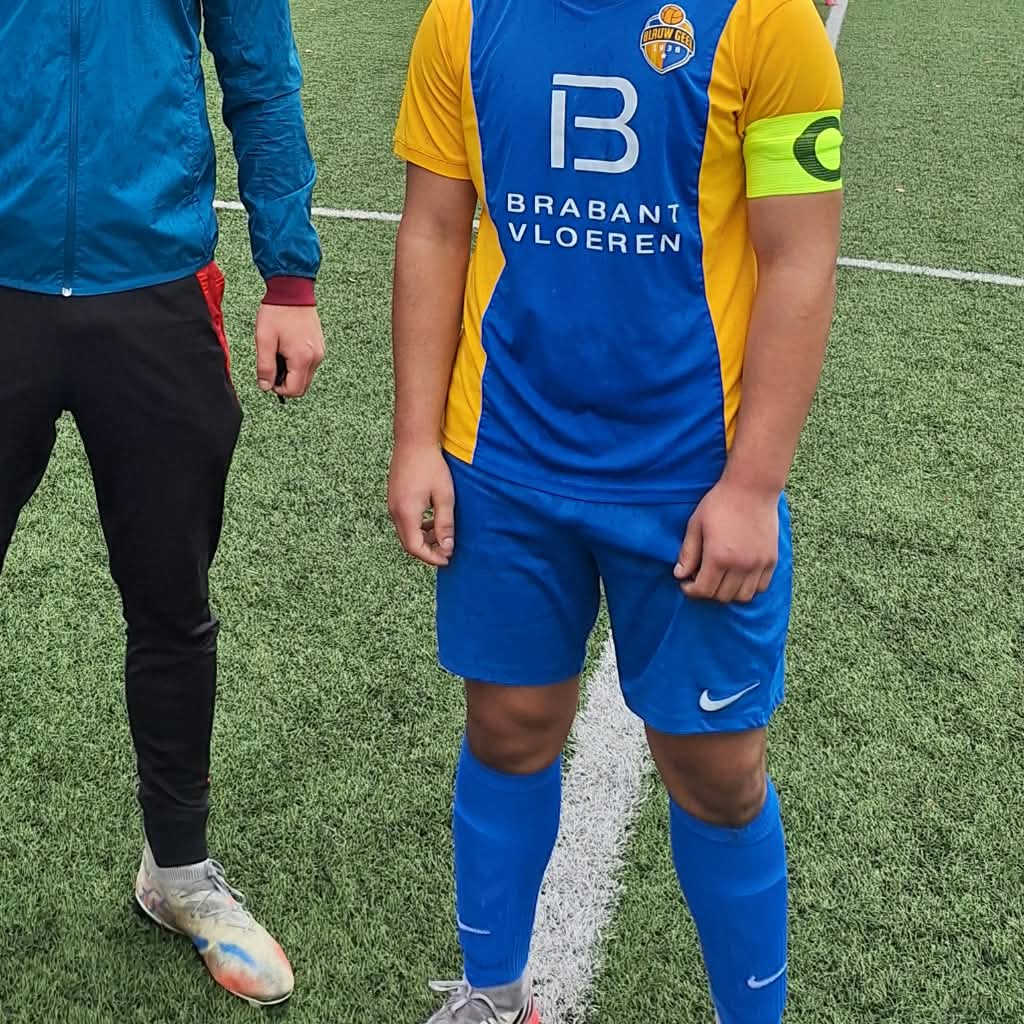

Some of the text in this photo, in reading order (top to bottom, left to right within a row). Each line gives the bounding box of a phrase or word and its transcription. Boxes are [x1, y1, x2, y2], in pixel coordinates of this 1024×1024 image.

[643, 28, 674, 42] BLAUW
[507, 192, 681, 224] BRABANT
[508, 222, 681, 255] VLOEREN
